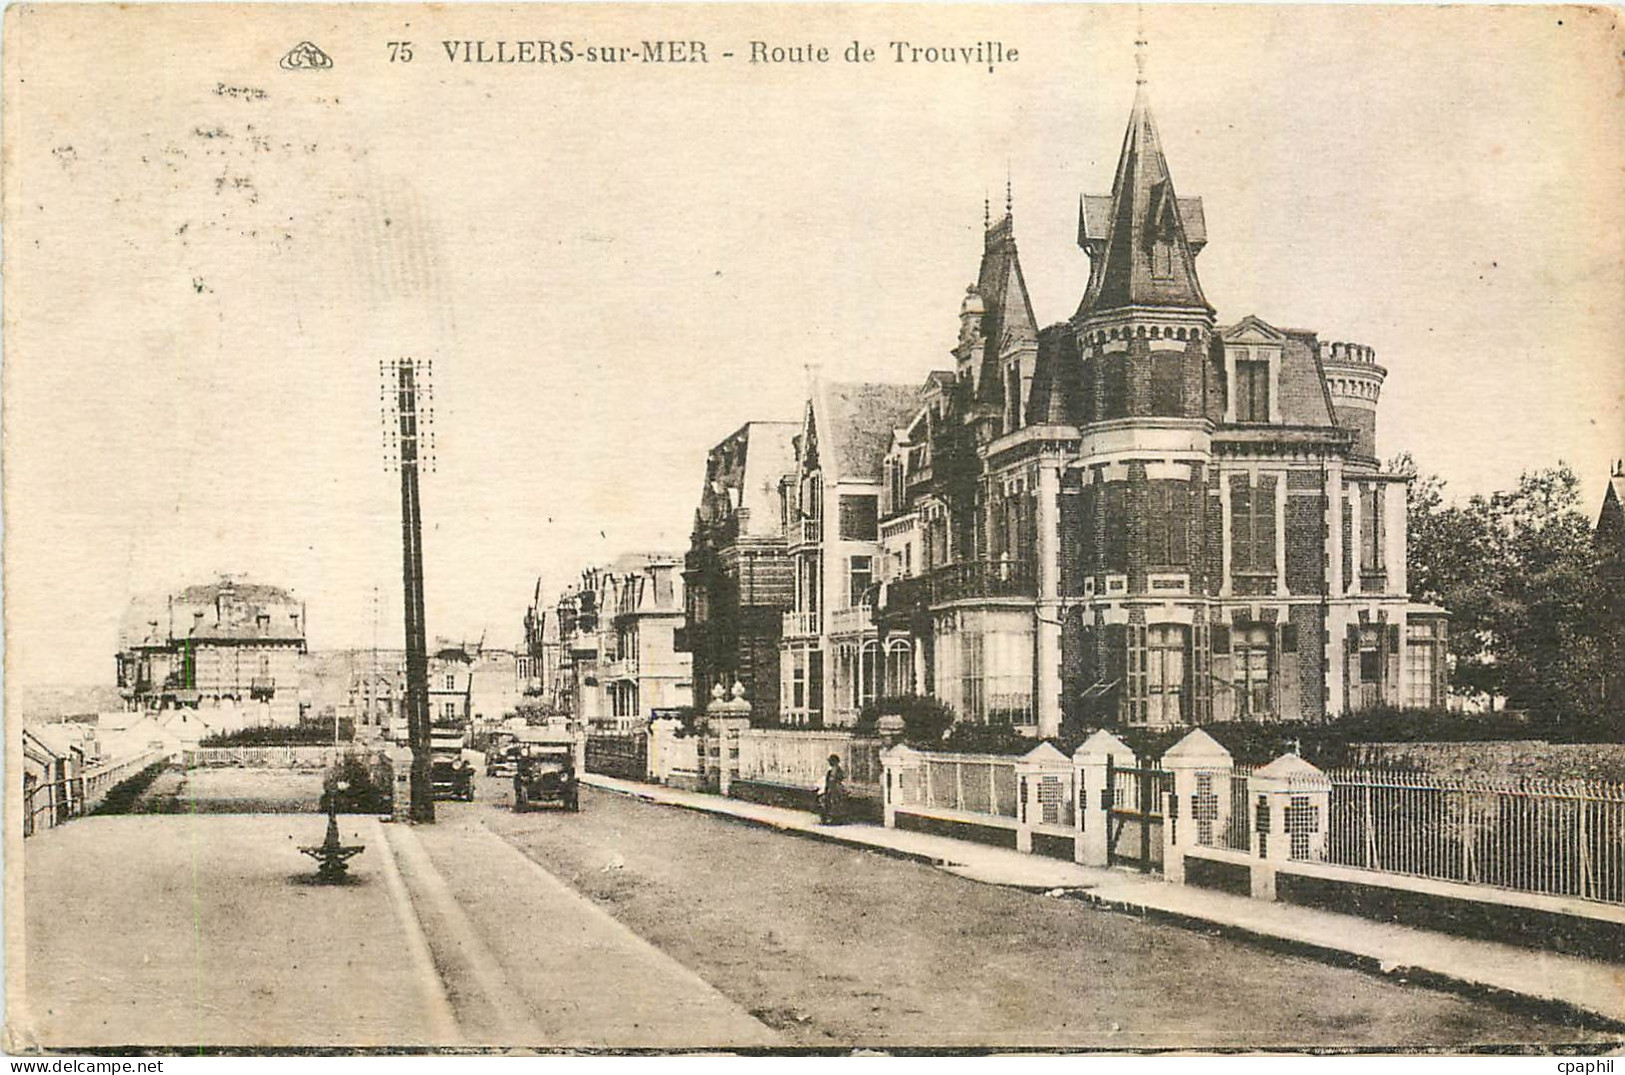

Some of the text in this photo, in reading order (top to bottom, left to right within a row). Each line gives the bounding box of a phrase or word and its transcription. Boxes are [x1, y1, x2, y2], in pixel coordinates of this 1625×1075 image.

[387, 41, 413, 63] 75
[442, 40, 708, 63] VILLERS-sur-MER
[749, 41, 829, 63] Route
[844, 40, 875, 63] de
[889, 41, 1019, 64] Trouville
